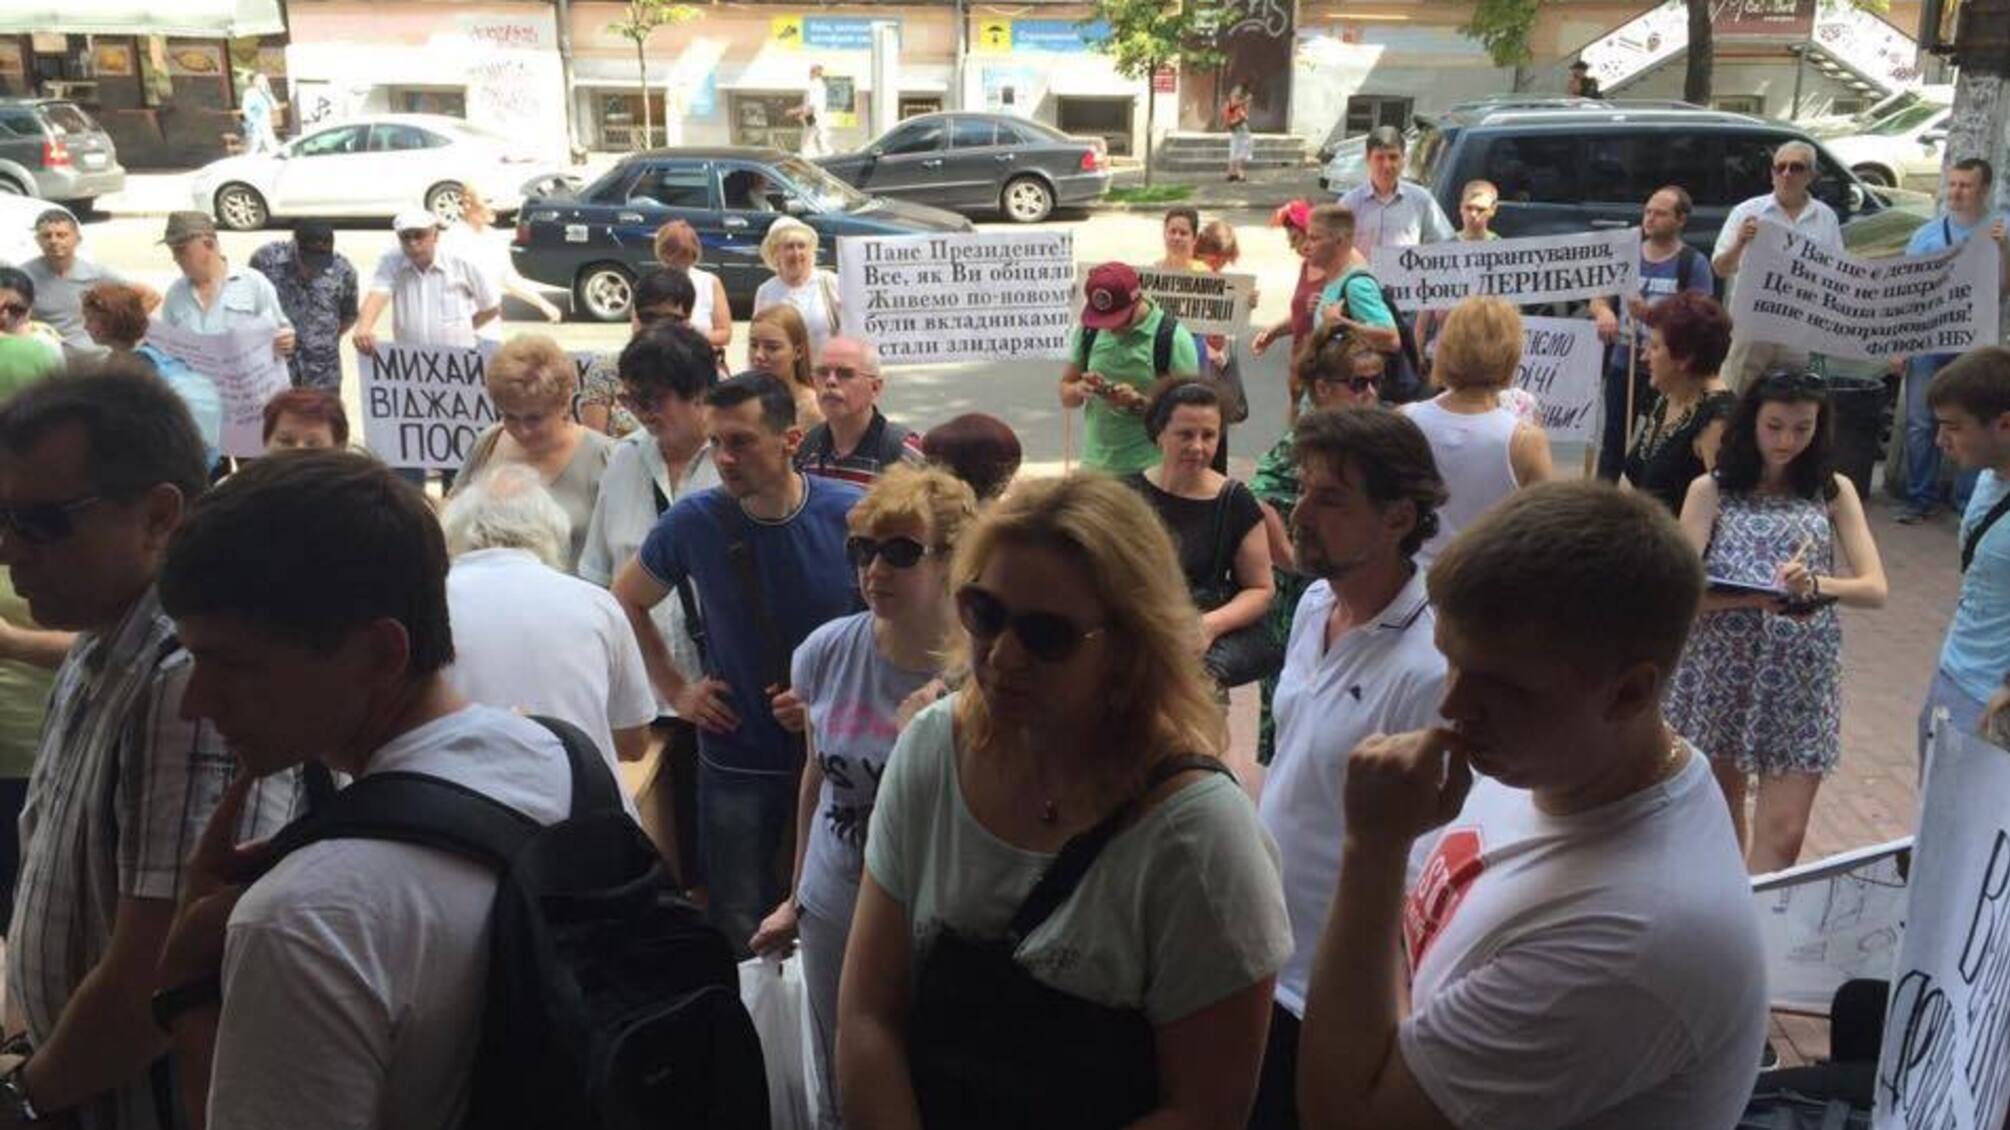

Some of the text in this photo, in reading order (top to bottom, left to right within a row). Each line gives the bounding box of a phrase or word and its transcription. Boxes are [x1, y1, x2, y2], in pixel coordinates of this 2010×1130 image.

[864, 241, 921, 261] Пане
[1399, 248, 1459, 274] Фонд
[1800, 239, 1834, 266] Вас
[864, 264, 910, 287] Все,
[917, 269, 942, 284] як
[952, 262, 981, 283] Ви
[1479, 260, 1631, 297] ДЕРИБАНУ?
[1762, 270, 1794, 295] Це
[1790, 258, 1818, 284] Ви
[866, 289, 959, 309] Живемо
[1752, 299, 1805, 321] наше
[865, 311, 1069, 334] були вкладниками
[878, 339, 938, 357] стали
[1937, 328, 1977, 348] НБУ
[372, 348, 487, 386] МИХАЙ
[370, 385, 502, 422] ВІДЖАЛ
